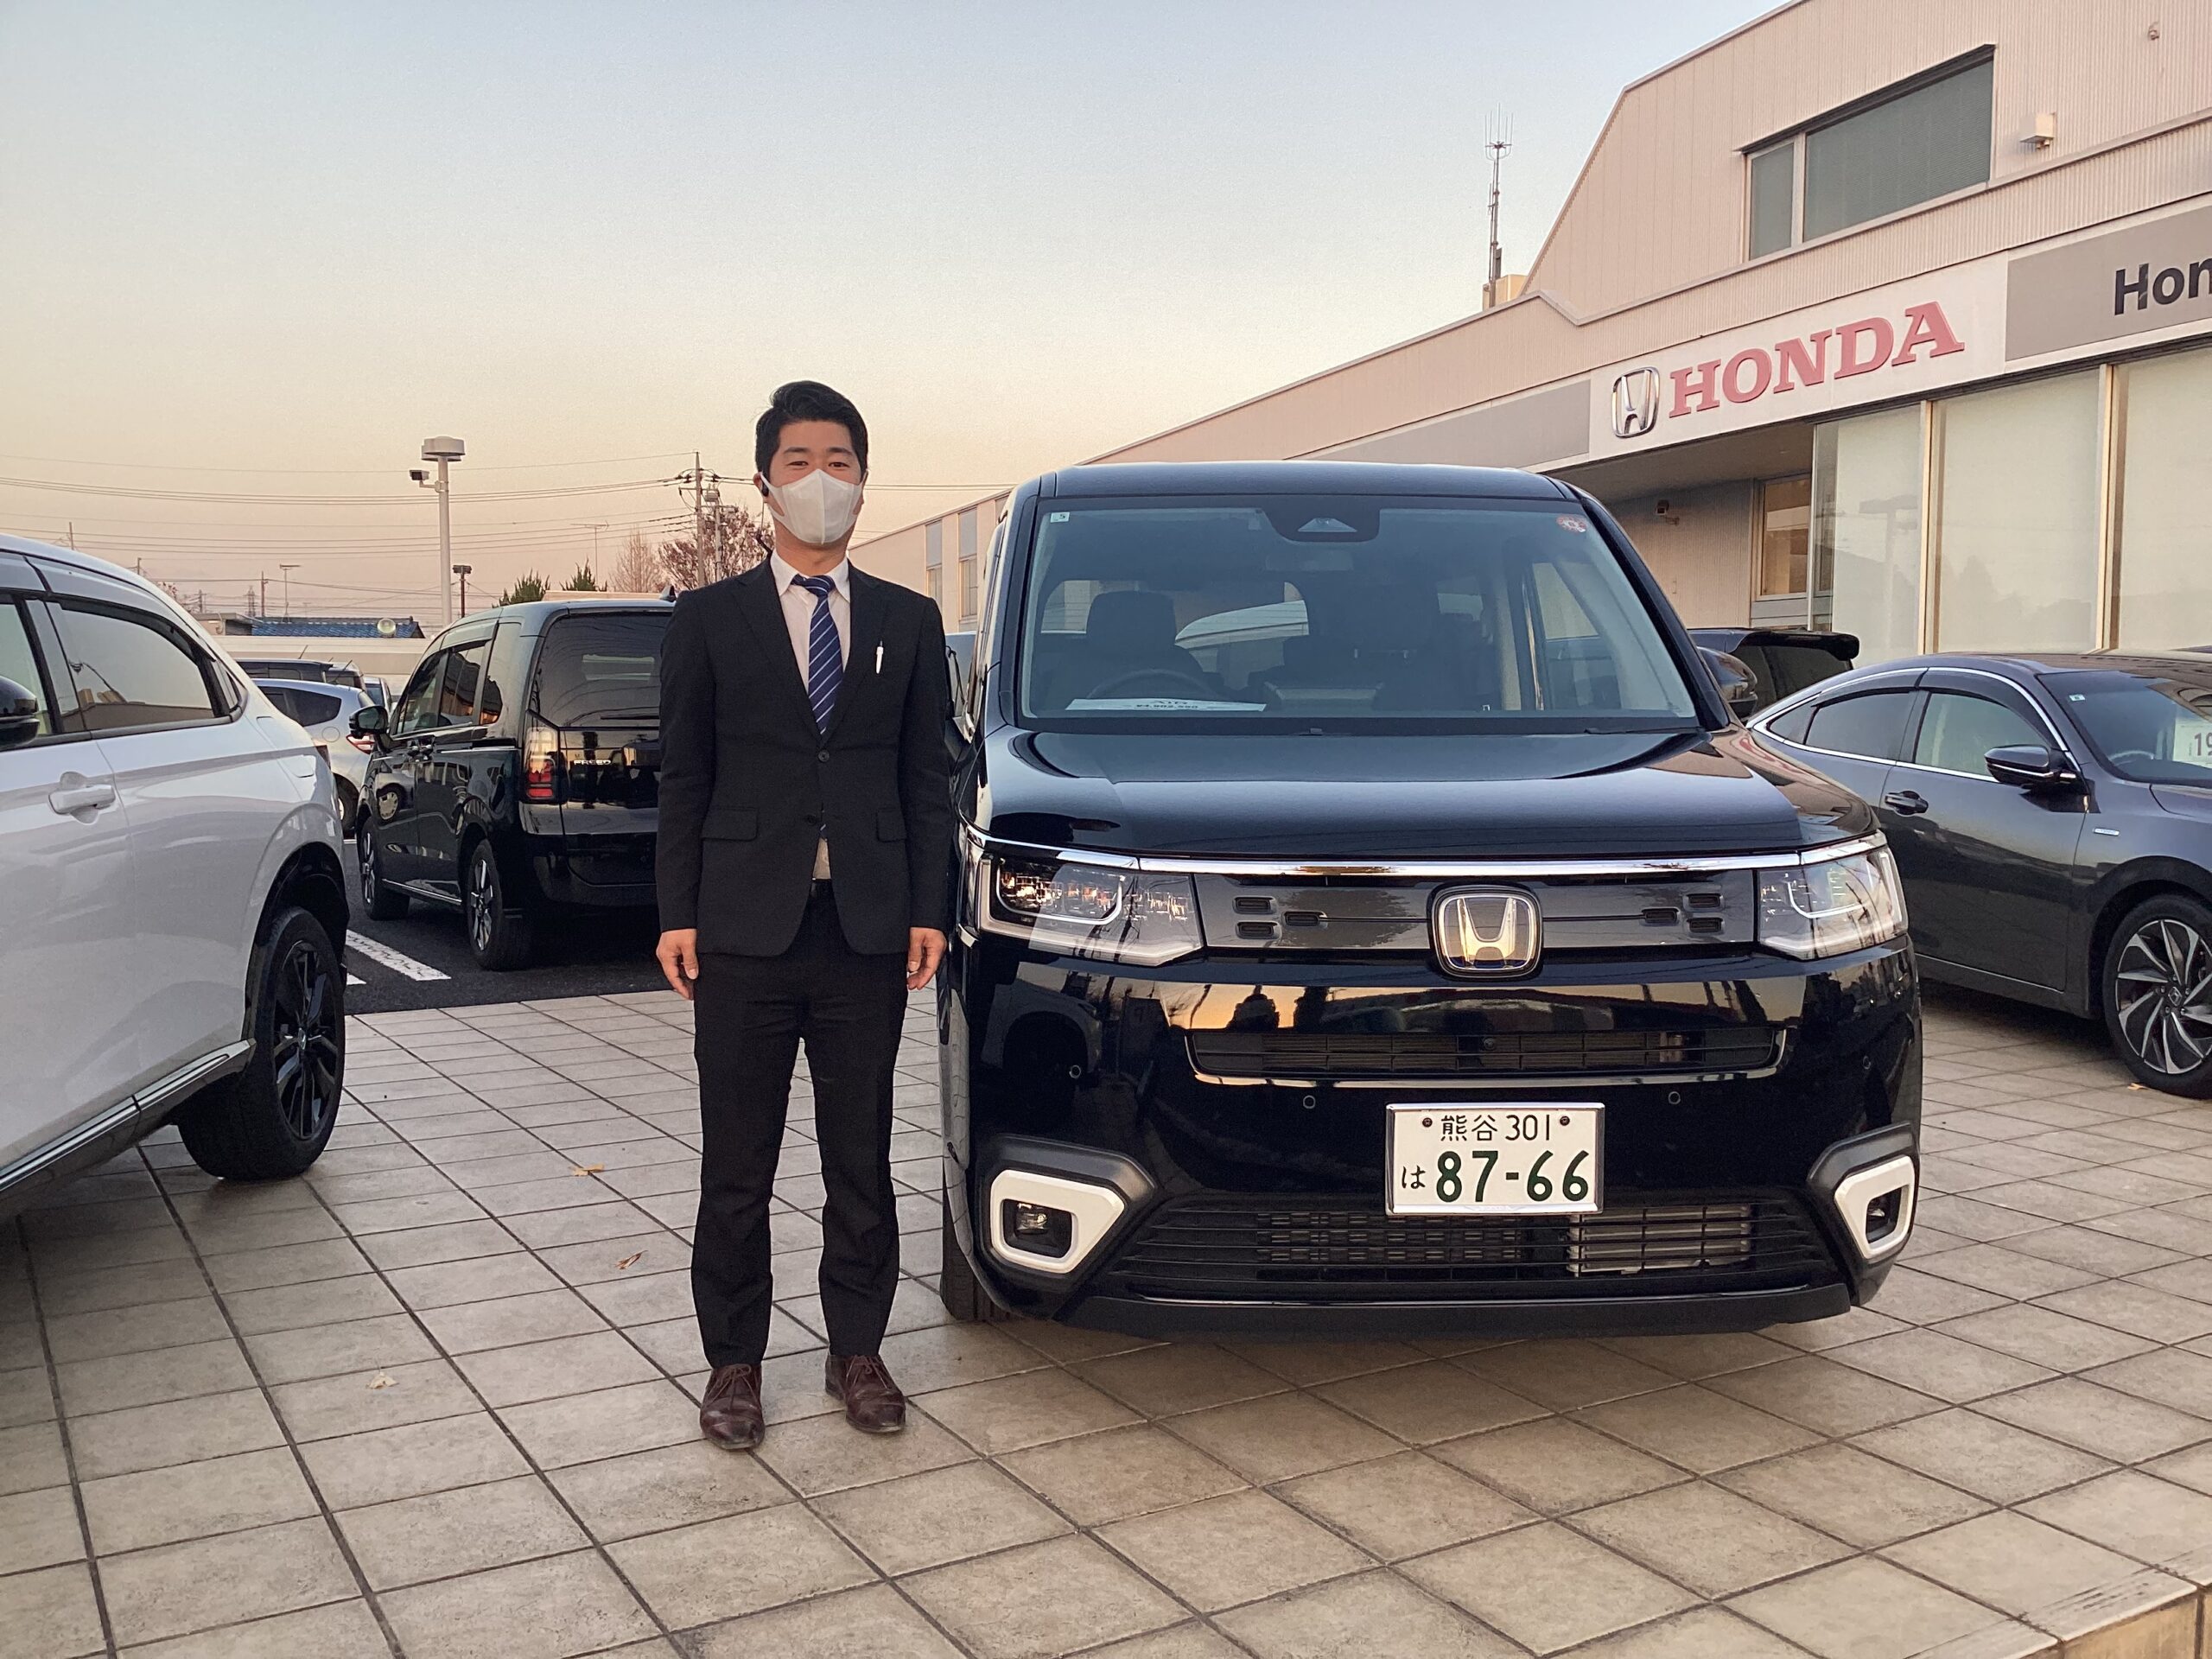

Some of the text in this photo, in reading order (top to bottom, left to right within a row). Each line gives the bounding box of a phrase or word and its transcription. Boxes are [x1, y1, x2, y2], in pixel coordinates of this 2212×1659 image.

[1669, 301, 1965, 418] HONDA
[1440, 1114, 1550, 1141] 熊谷 301
[1401, 1149, 1590, 1203] は 87-66
